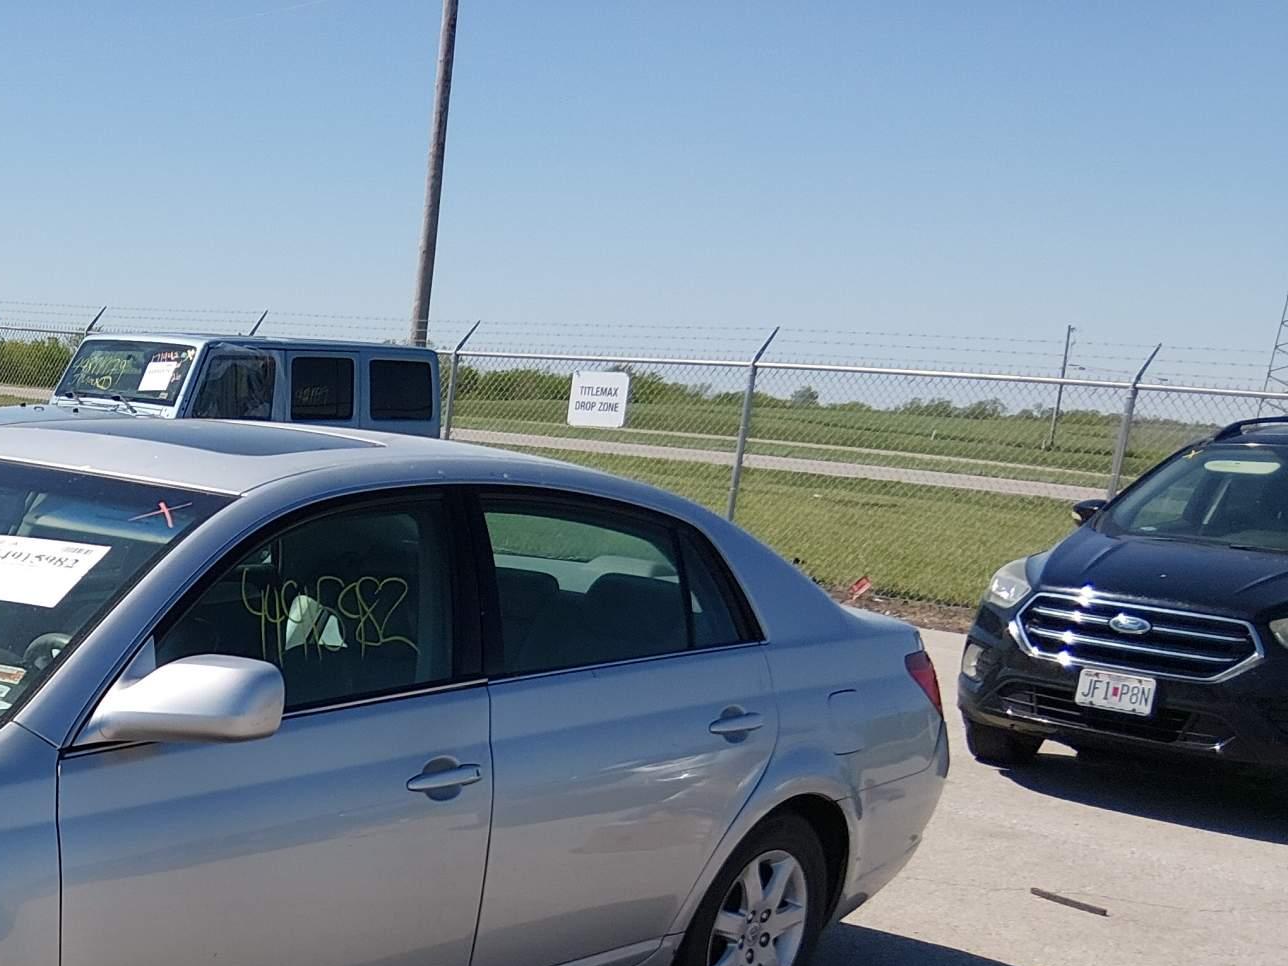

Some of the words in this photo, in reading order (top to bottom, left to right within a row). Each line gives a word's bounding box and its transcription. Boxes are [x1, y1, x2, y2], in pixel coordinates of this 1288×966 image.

[579, 386, 619, 397] TITLEMAX
[574, 400, 596, 411] DROP
[598, 401, 619, 412] ZONE
[1118, 683, 1151, 707] P8N
